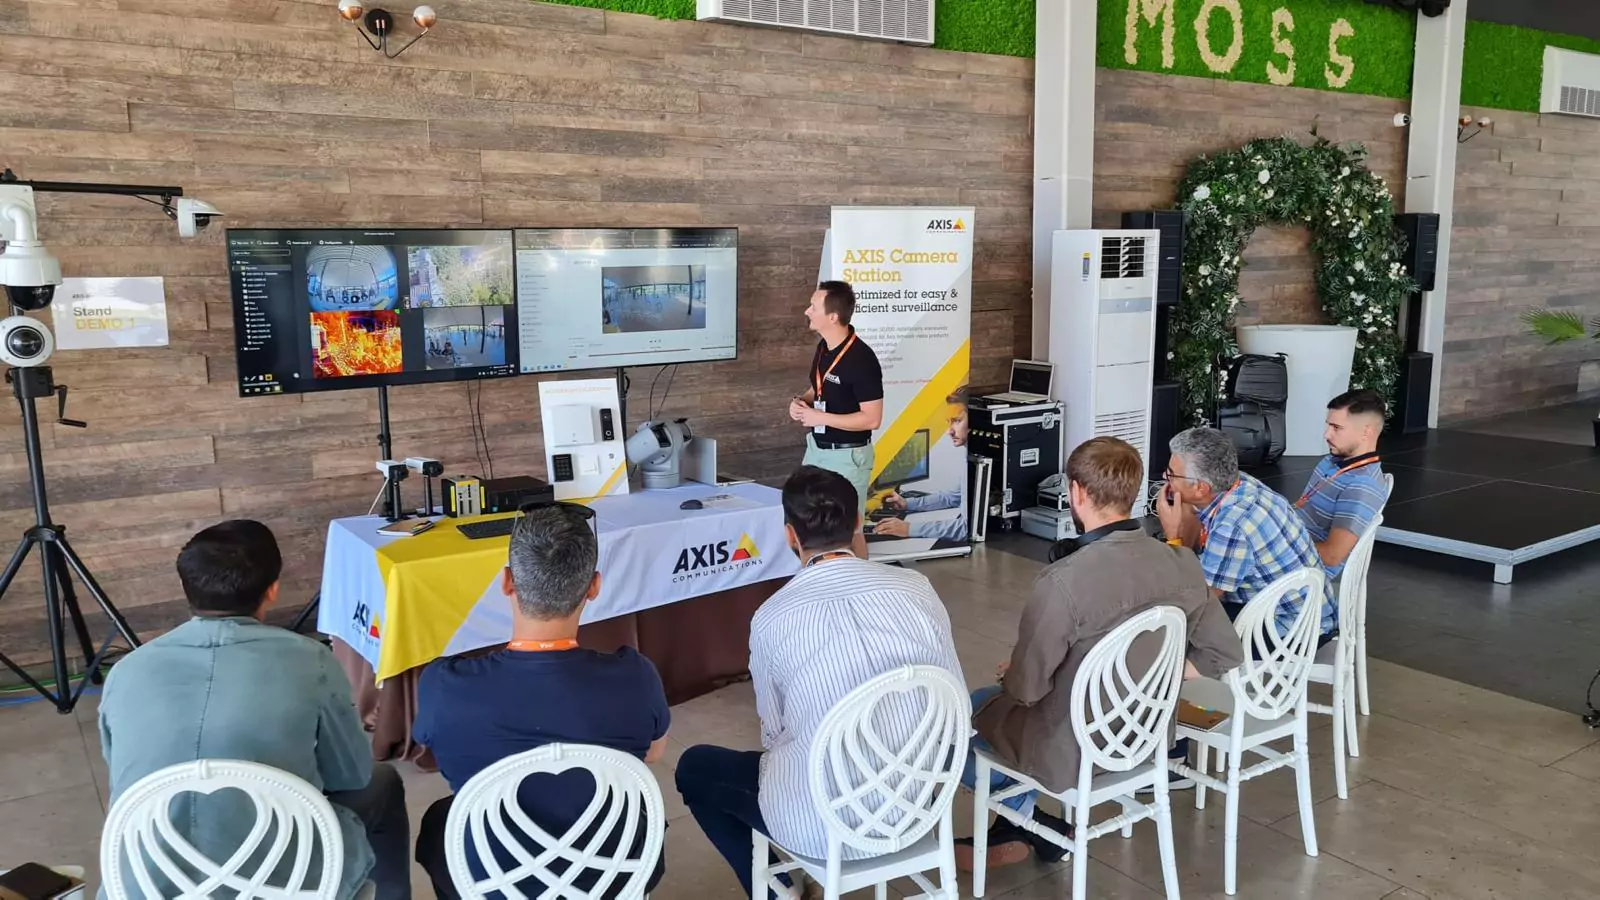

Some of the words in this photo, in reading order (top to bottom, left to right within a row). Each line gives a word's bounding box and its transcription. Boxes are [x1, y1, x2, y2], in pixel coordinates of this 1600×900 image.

[1123, 0, 1355, 88] MOSS
[926, 219, 953, 230] AXIS
[843, 249, 885, 264] AXIS
[890, 248, 958, 264] Camera
[843, 268, 902, 283] Station
[853, 289, 901, 301] ptimized
[904, 289, 918, 299] for
[920, 290, 947, 301] easy
[950, 288, 959, 299] &
[73, 305, 112, 316] Stand
[854, 303, 889, 313] ficient
[891, 302, 958, 313] surveillance
[76, 318, 123, 330] DEMO
[672, 540, 730, 575] AXIS
[672, 559, 763, 583] COMMUNICATIONS
